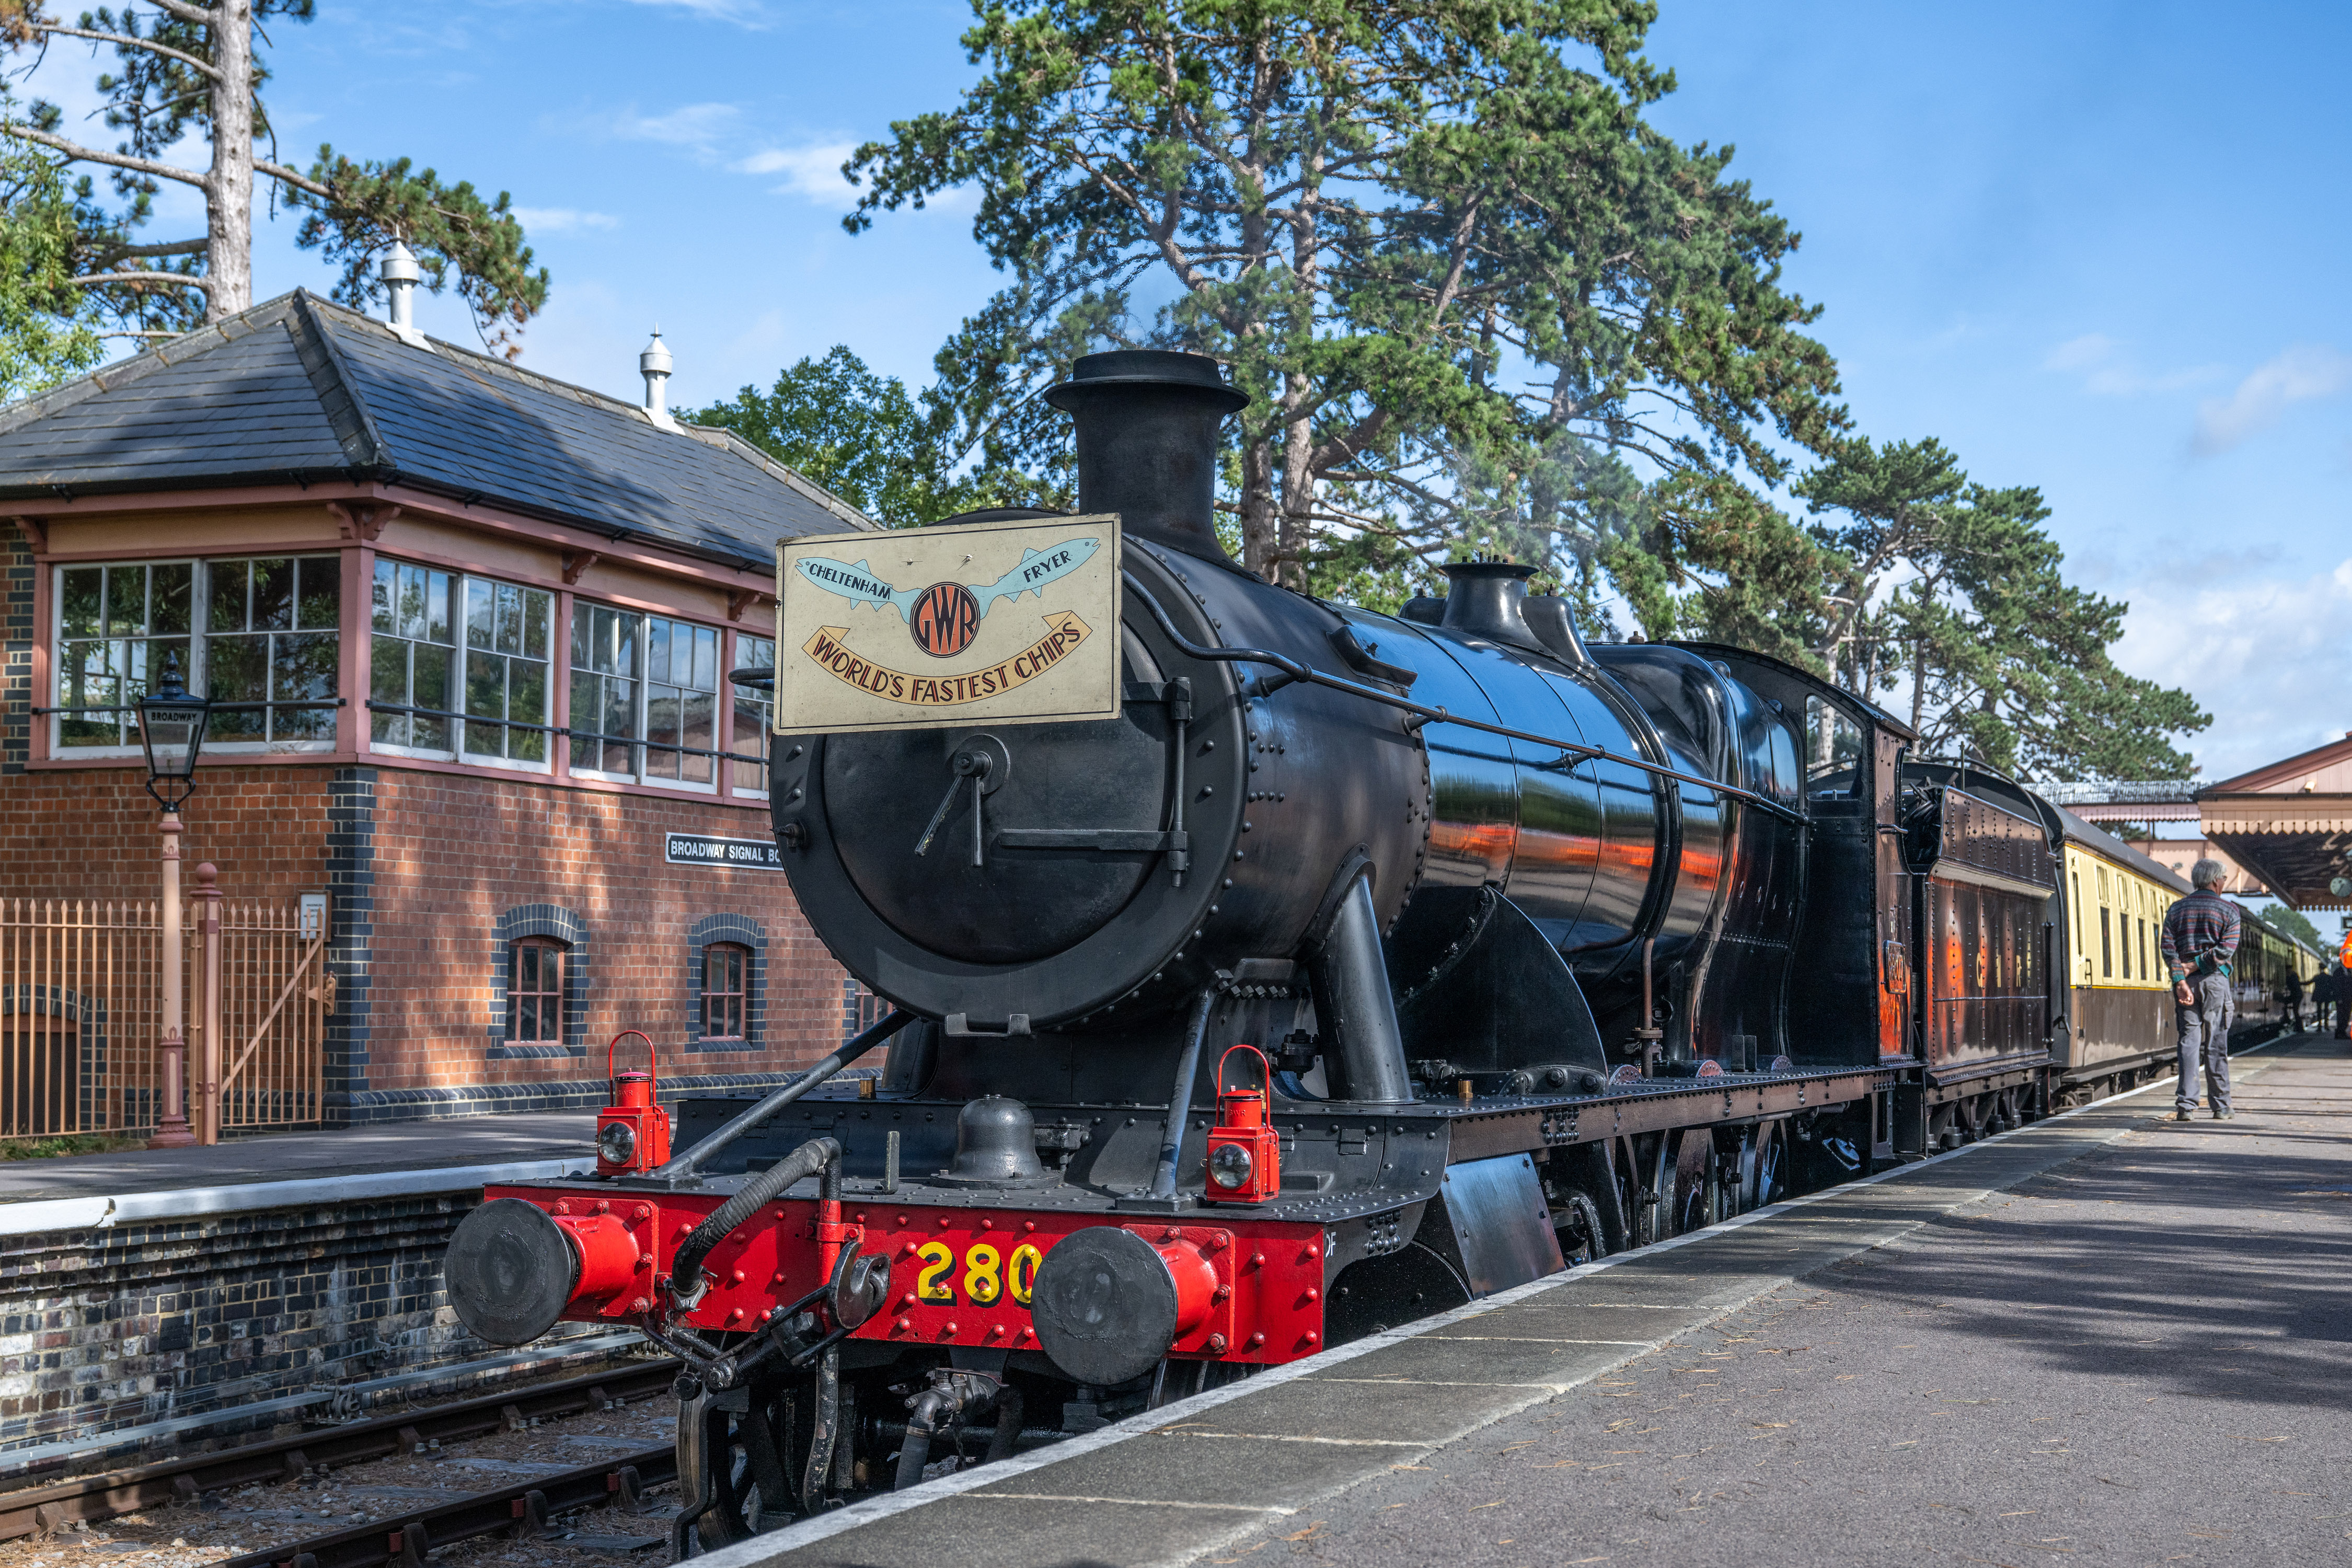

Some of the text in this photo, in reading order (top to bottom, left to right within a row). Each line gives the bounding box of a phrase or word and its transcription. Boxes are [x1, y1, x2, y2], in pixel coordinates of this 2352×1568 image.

[809, 562, 891, 600] CHELTENHAM
[1023, 550, 1072, 583] FRYER
[914, 585, 977, 654] GWR
[812, 621, 1080, 703] WORLD'S FASTEST CHIPS
[151, 712, 197, 721] BROADWAY
[671, 840, 781, 863] BROADWAY SIGNAL BO
[917, 1241, 1043, 1307] 280
